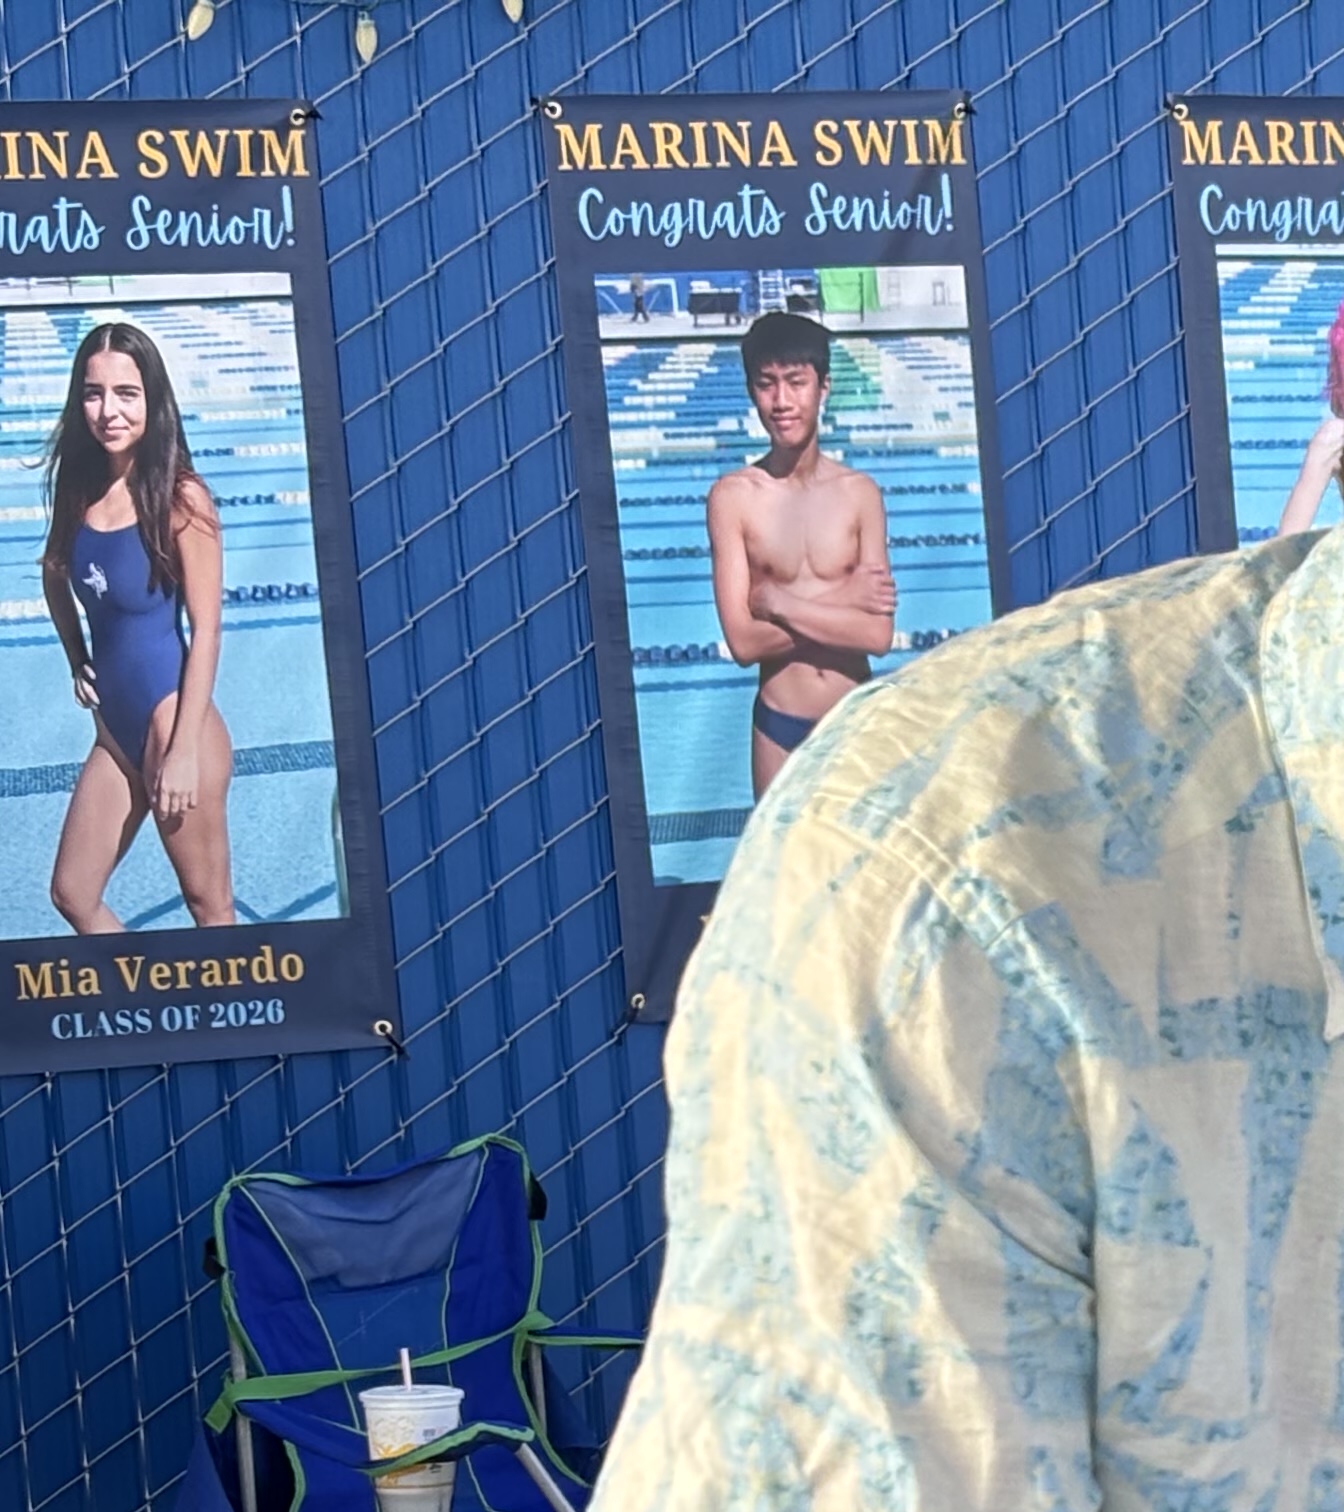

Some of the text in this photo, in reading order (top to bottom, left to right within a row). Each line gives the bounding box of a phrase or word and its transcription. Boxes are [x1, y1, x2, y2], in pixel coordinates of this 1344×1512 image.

[0, 129, 311, 180] INA SWIM
[554, 119, 967, 170] MARINA SWIM
[126, 184, 296, 250] Senior!
[578, 173, 954, 249] Congrats Senior!
[14, 945, 306, 1001] Mia Verardo
[50, 998, 286, 1041] CLASS OF 2026
